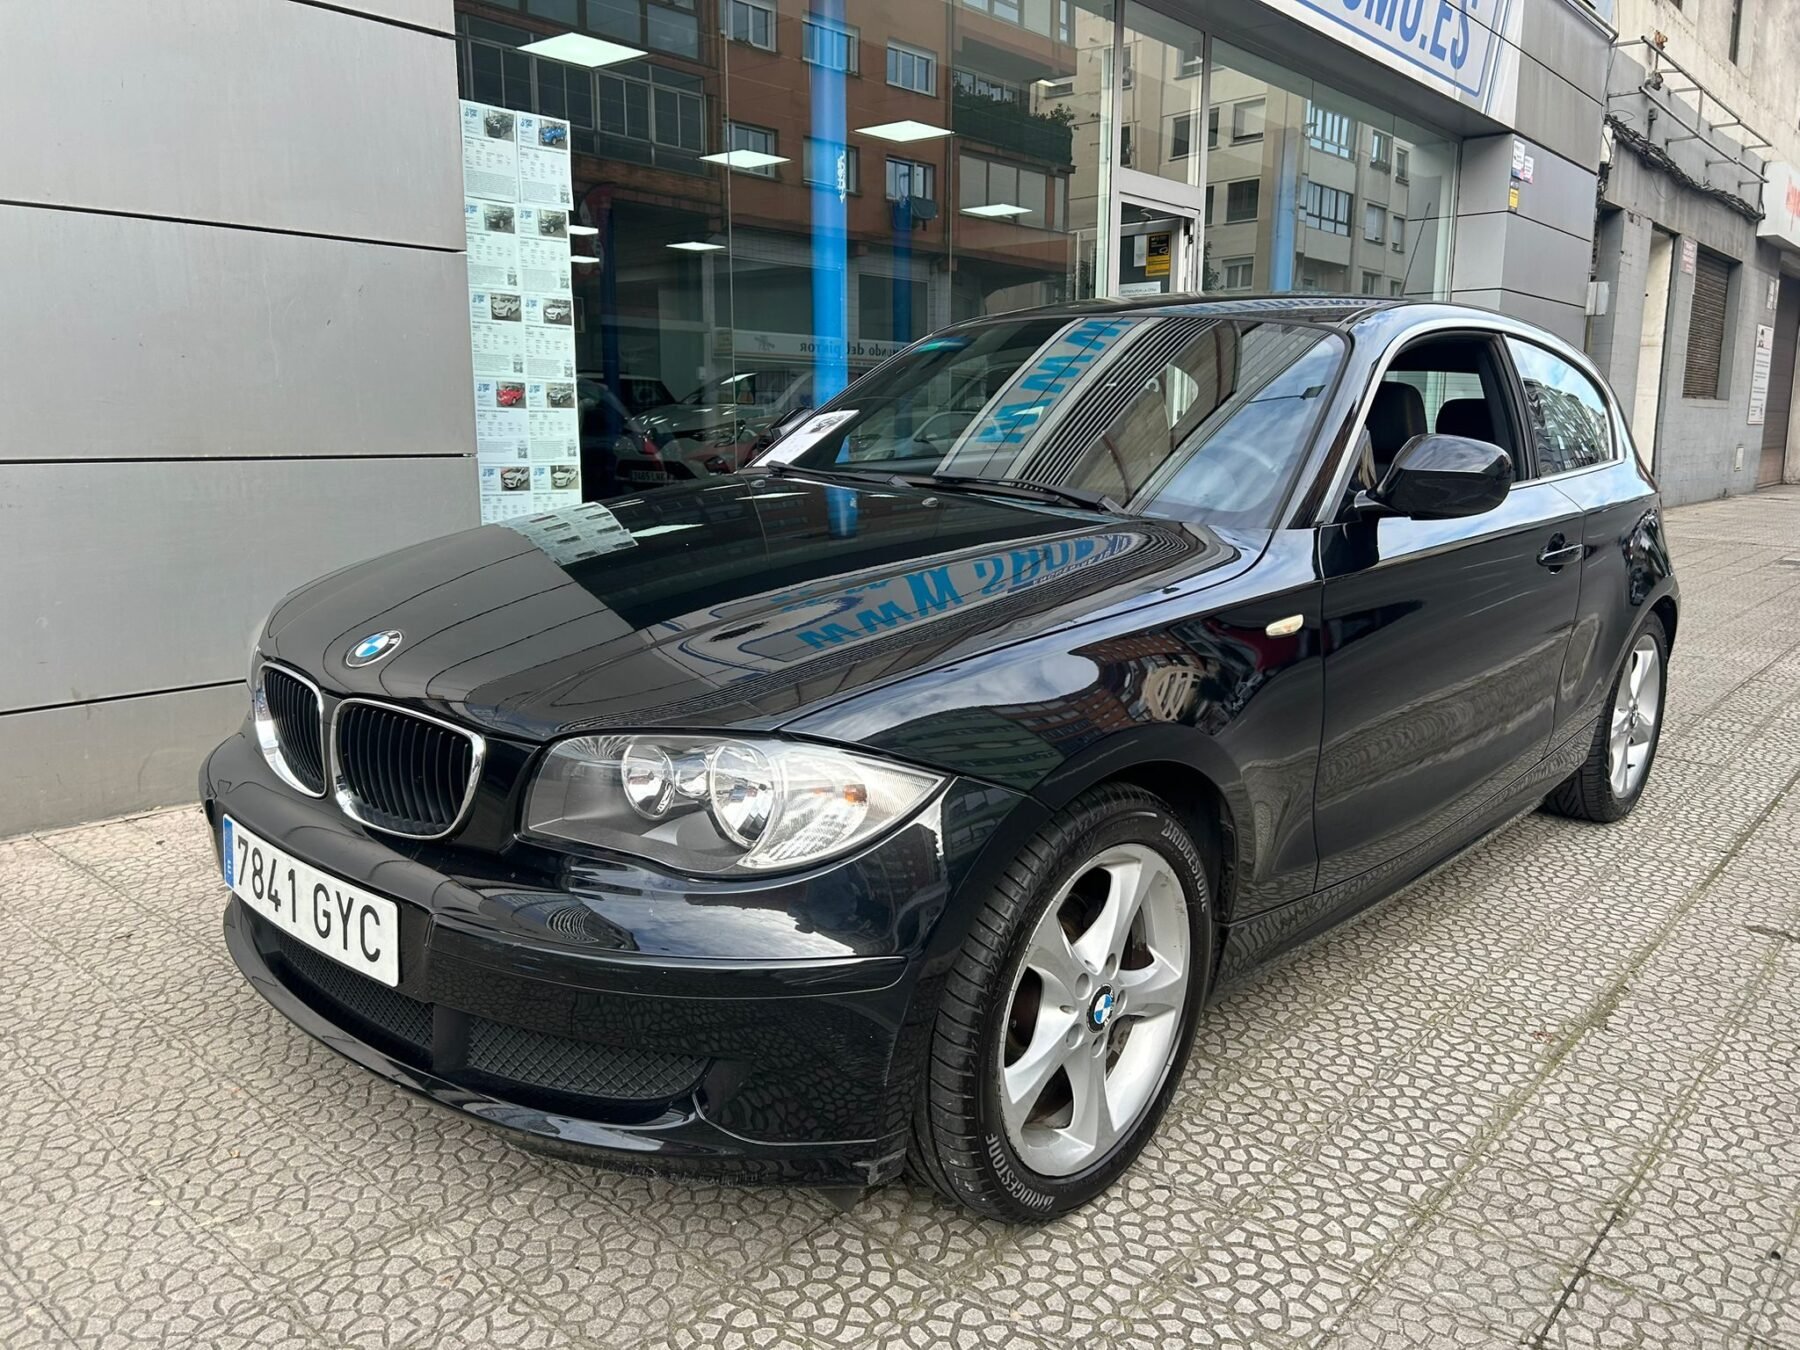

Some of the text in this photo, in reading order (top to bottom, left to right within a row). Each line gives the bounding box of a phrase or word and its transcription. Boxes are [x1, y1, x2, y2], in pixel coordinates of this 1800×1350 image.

[237, 834, 381, 963] 7841 GYC
[1161, 818, 1208, 913] BRIDGESTONE
[986, 1132, 1055, 1213] BRIDGESTONE
